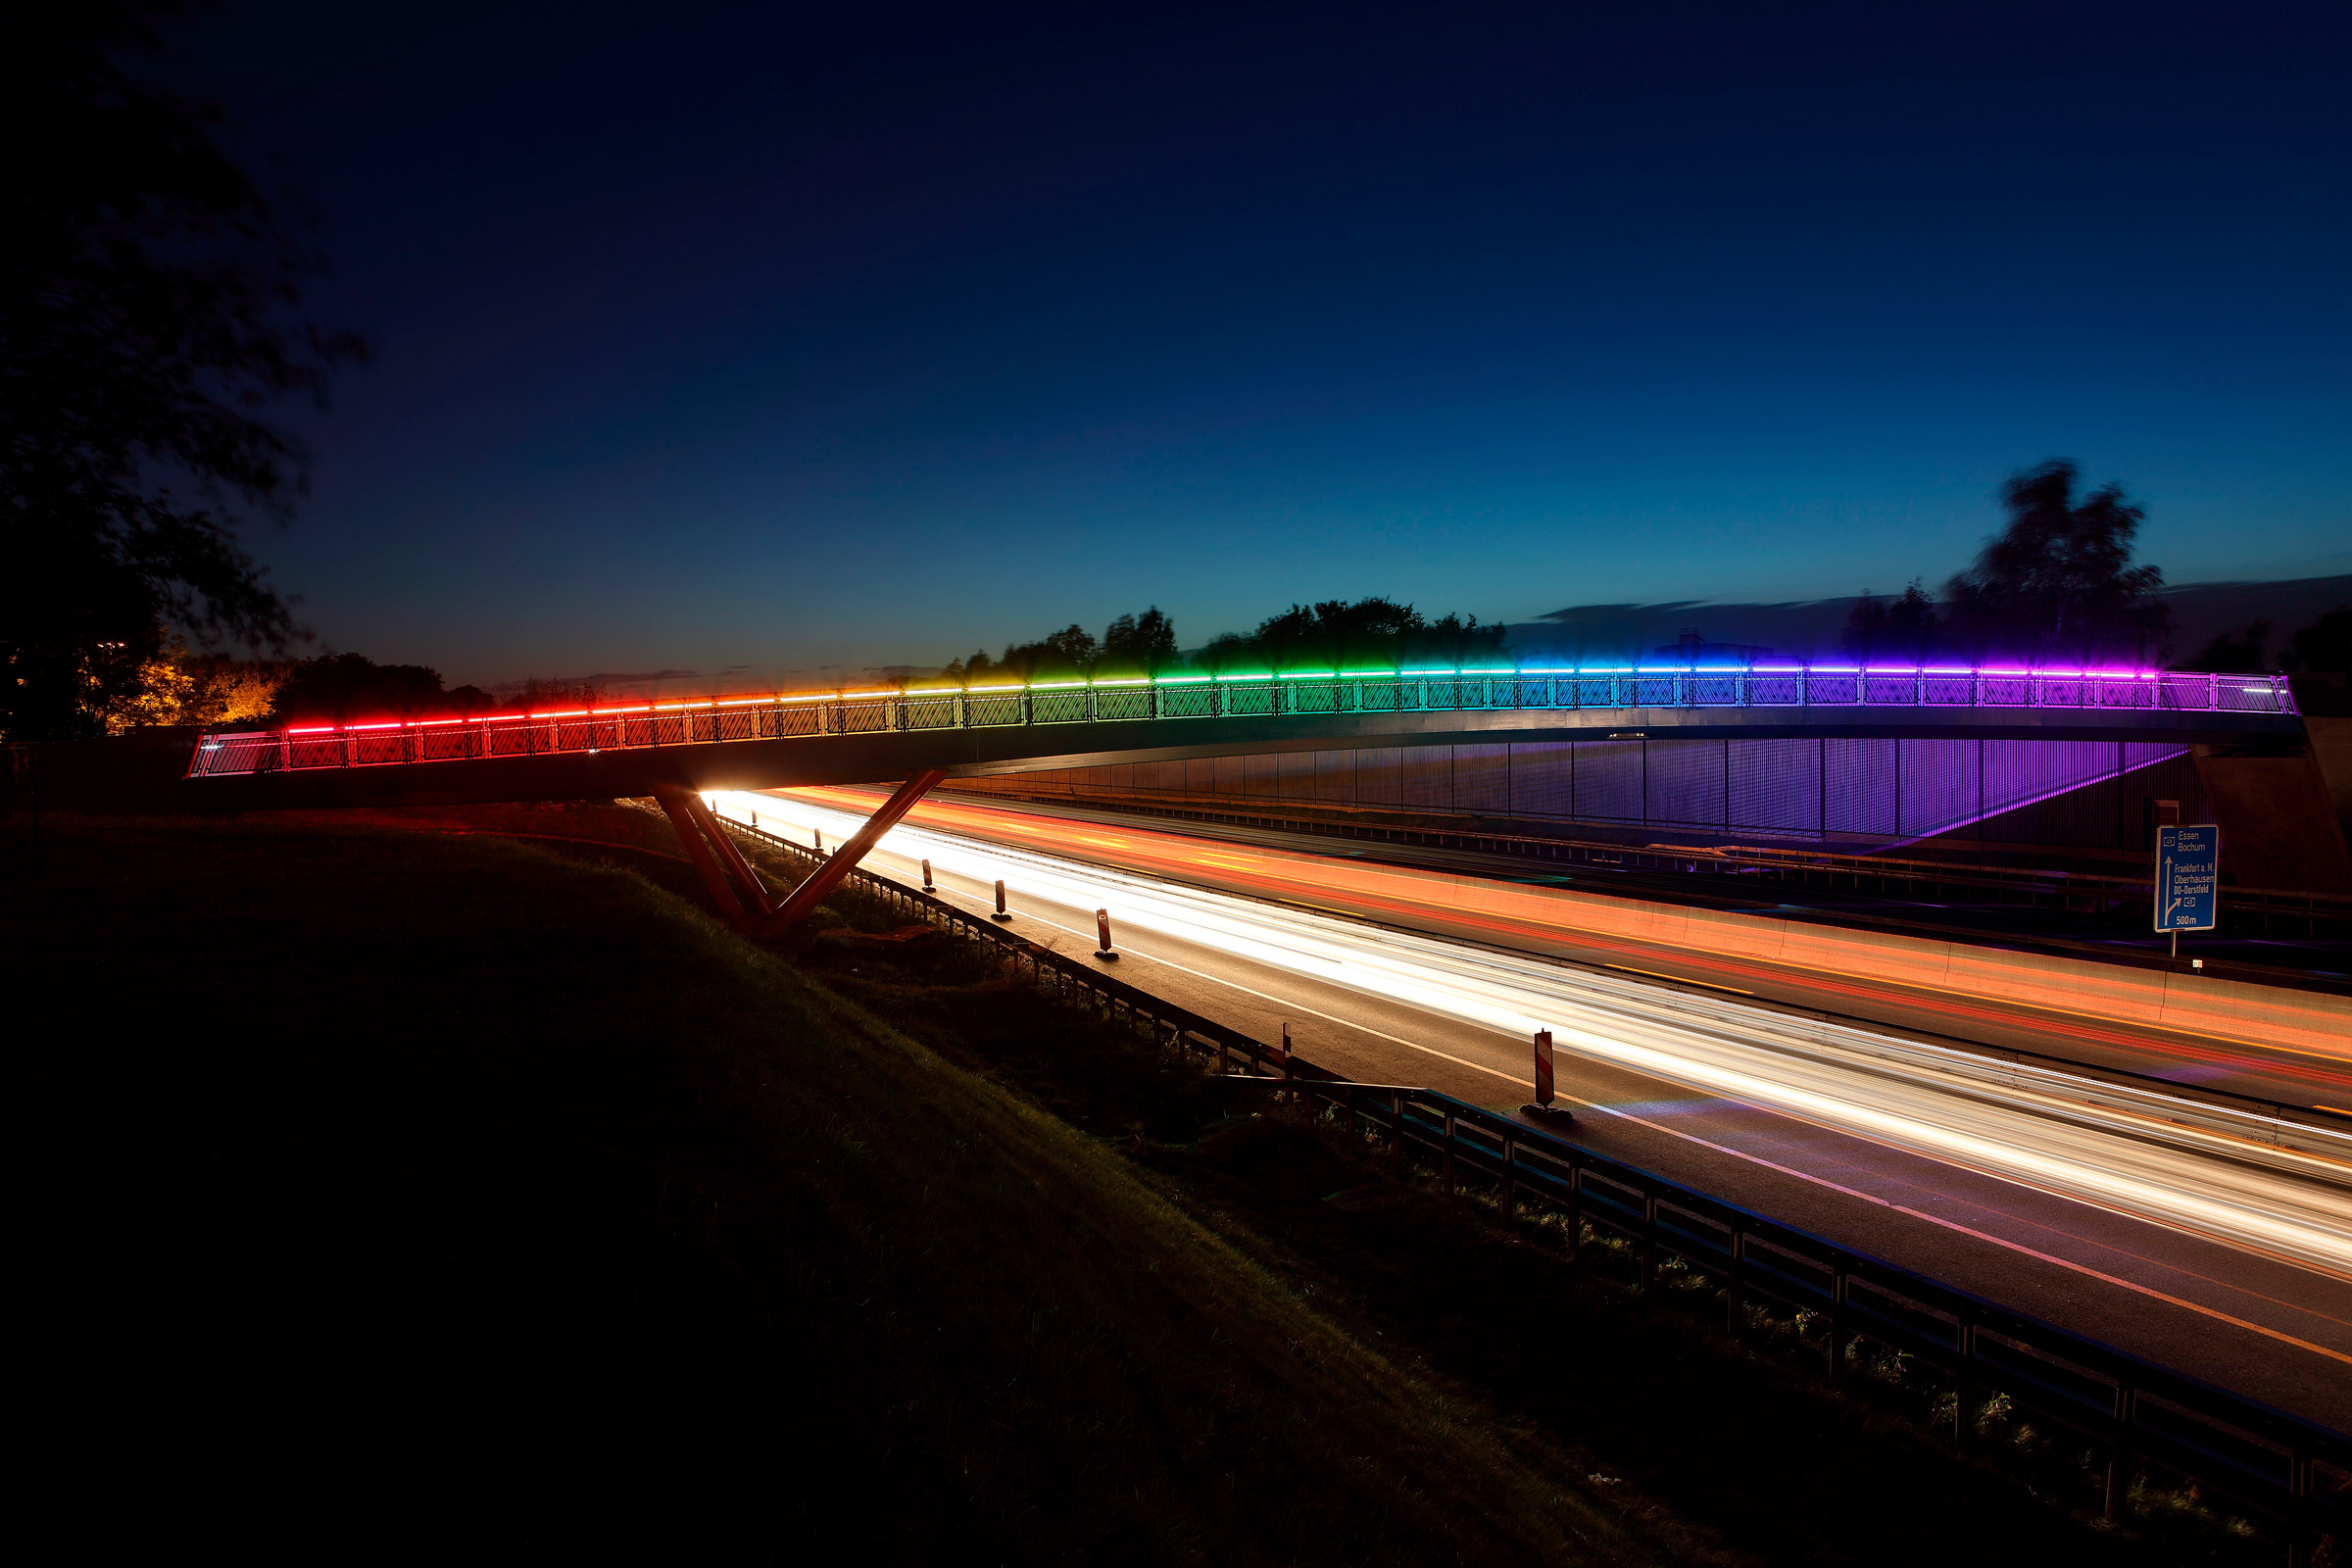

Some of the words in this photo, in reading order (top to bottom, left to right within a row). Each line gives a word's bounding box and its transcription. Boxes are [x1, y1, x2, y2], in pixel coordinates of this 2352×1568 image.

[2179, 831, 2199, 840] Essen
[2178, 842, 2205, 852] Bochum
[2175, 863, 2200, 873] Frankfurt
[2174, 874, 2215, 884] Oberhausen
[2174, 884, 2209, 895] DO-Dorstfeld
